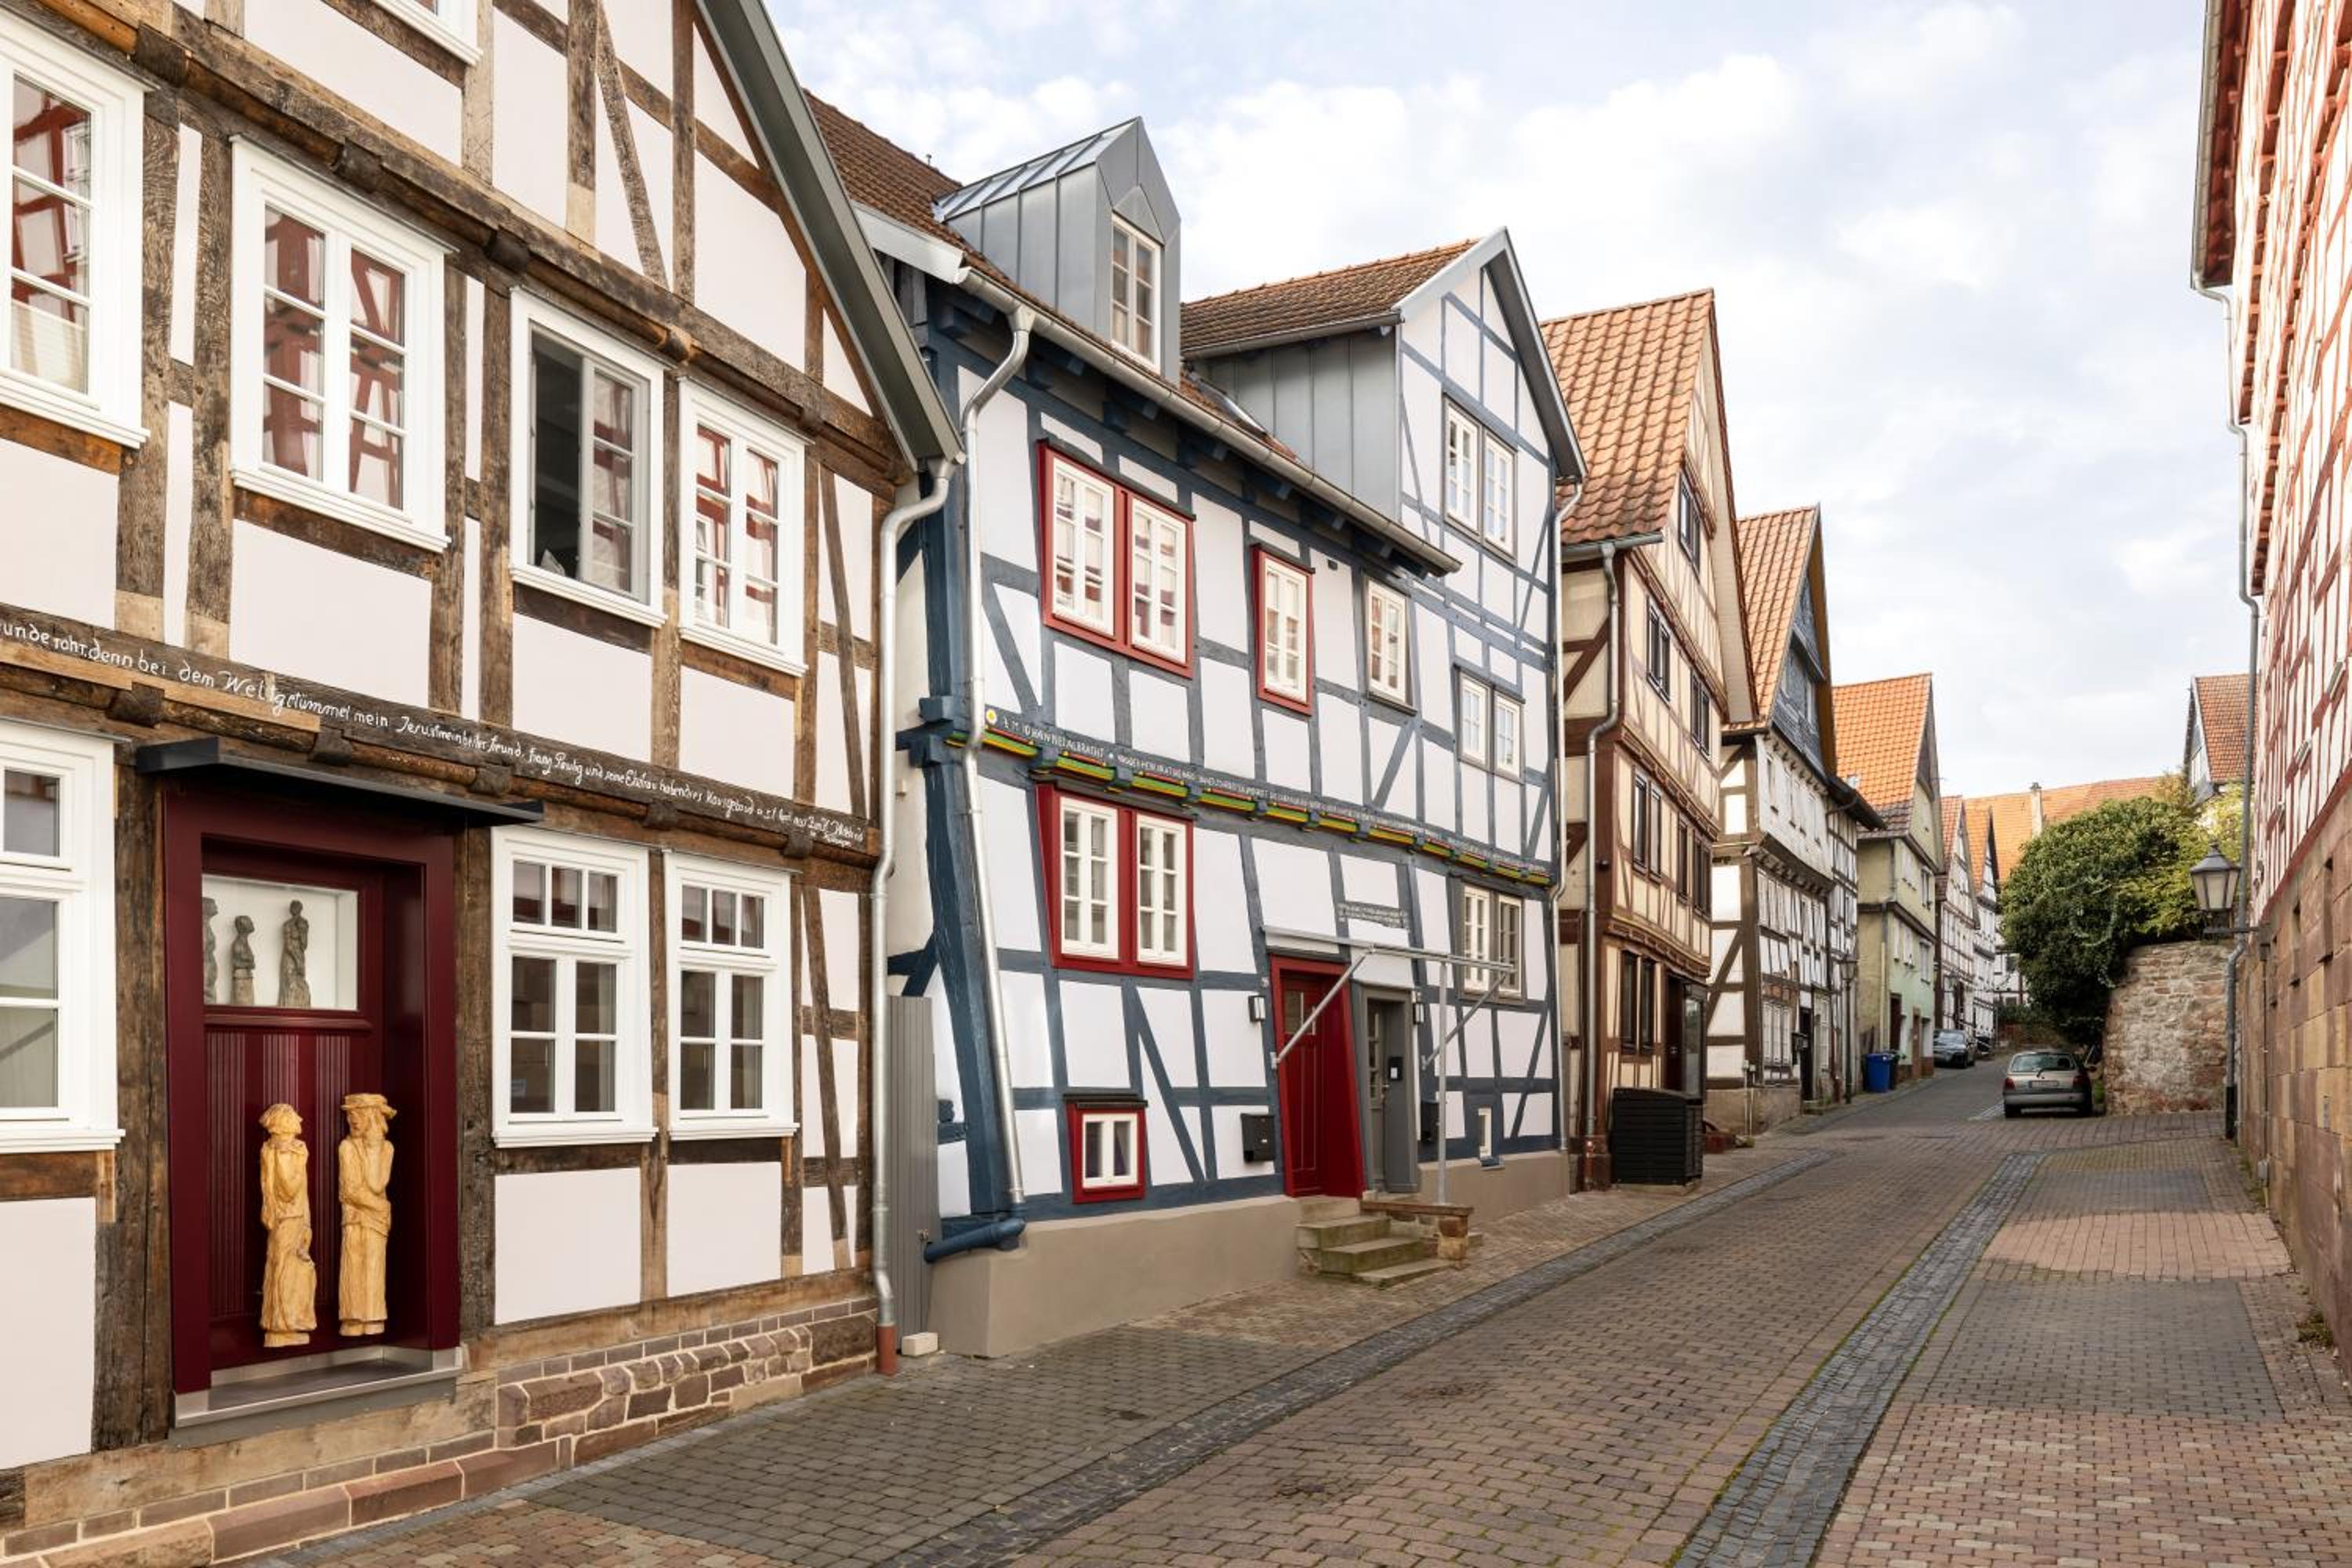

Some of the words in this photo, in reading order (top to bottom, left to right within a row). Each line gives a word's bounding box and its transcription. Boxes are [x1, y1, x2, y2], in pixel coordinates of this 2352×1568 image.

[0, 623, 50, 644] unde
[89, 637, 132, 667] denn
[137, 648, 166, 674] bei
[179, 659, 214, 688] dem
[354, 712, 388, 727] mein
